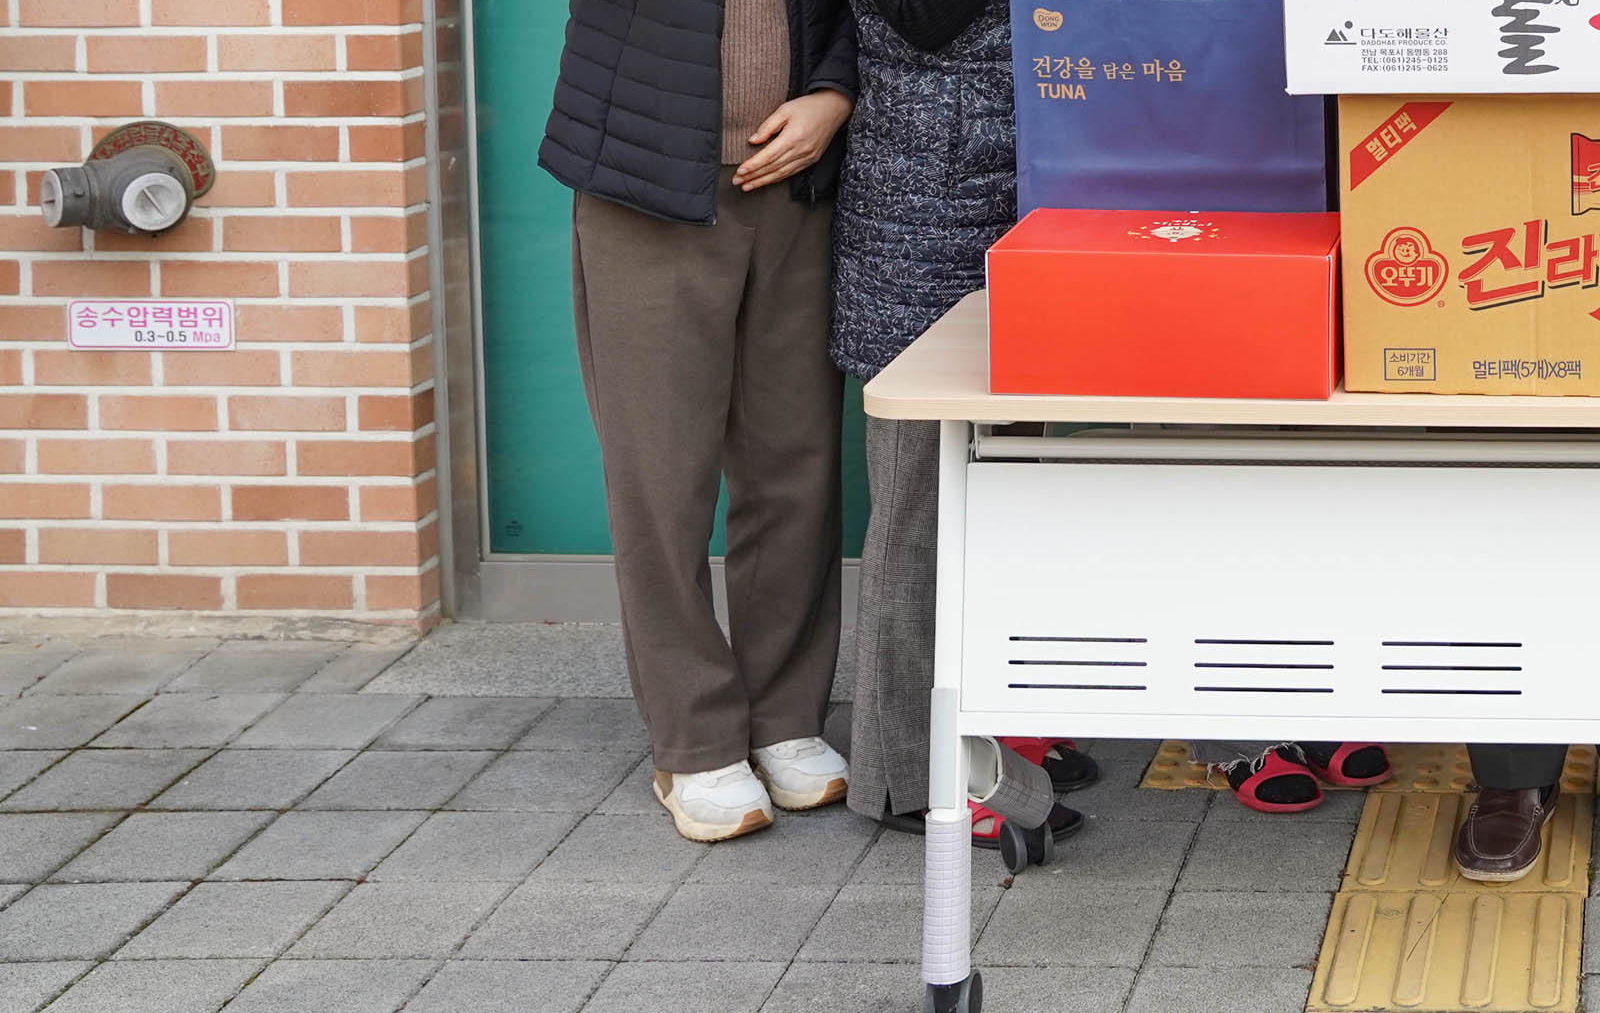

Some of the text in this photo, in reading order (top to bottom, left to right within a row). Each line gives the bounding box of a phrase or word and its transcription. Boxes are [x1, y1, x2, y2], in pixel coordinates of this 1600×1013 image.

[1038, 14, 1059, 22] DONG
[1040, 20, 1058, 28] WON
[1360, 28, 1450, 39] 다도해물산
[1362, 48, 1377, 56] 전남
[1380, 48, 1404, 56] 목포시
[1433, 48, 1448, 56] 288
[1362, 56, 1448, 64] TEL:(061)245-0125
[1032, 55, 1186, 82] 건강을 담은 마음
[1362, 64, 1448, 72] FAX:(061)245-0625
[1036, 83, 1087, 100] TUNA
[1364, 111, 1418, 162] 멀티팩
[1380, 266, 1434, 287] 오뚜기
[76, 306, 223, 328] 송수압력범위
[134, 330, 221, 344] 0.3~0.5 Mpa
[1389, 352, 1431, 364] 소비기간
[1396, 365, 1424, 378] 6개월
[1472, 359, 1582, 380] 멀티팩(5개)X8팩
